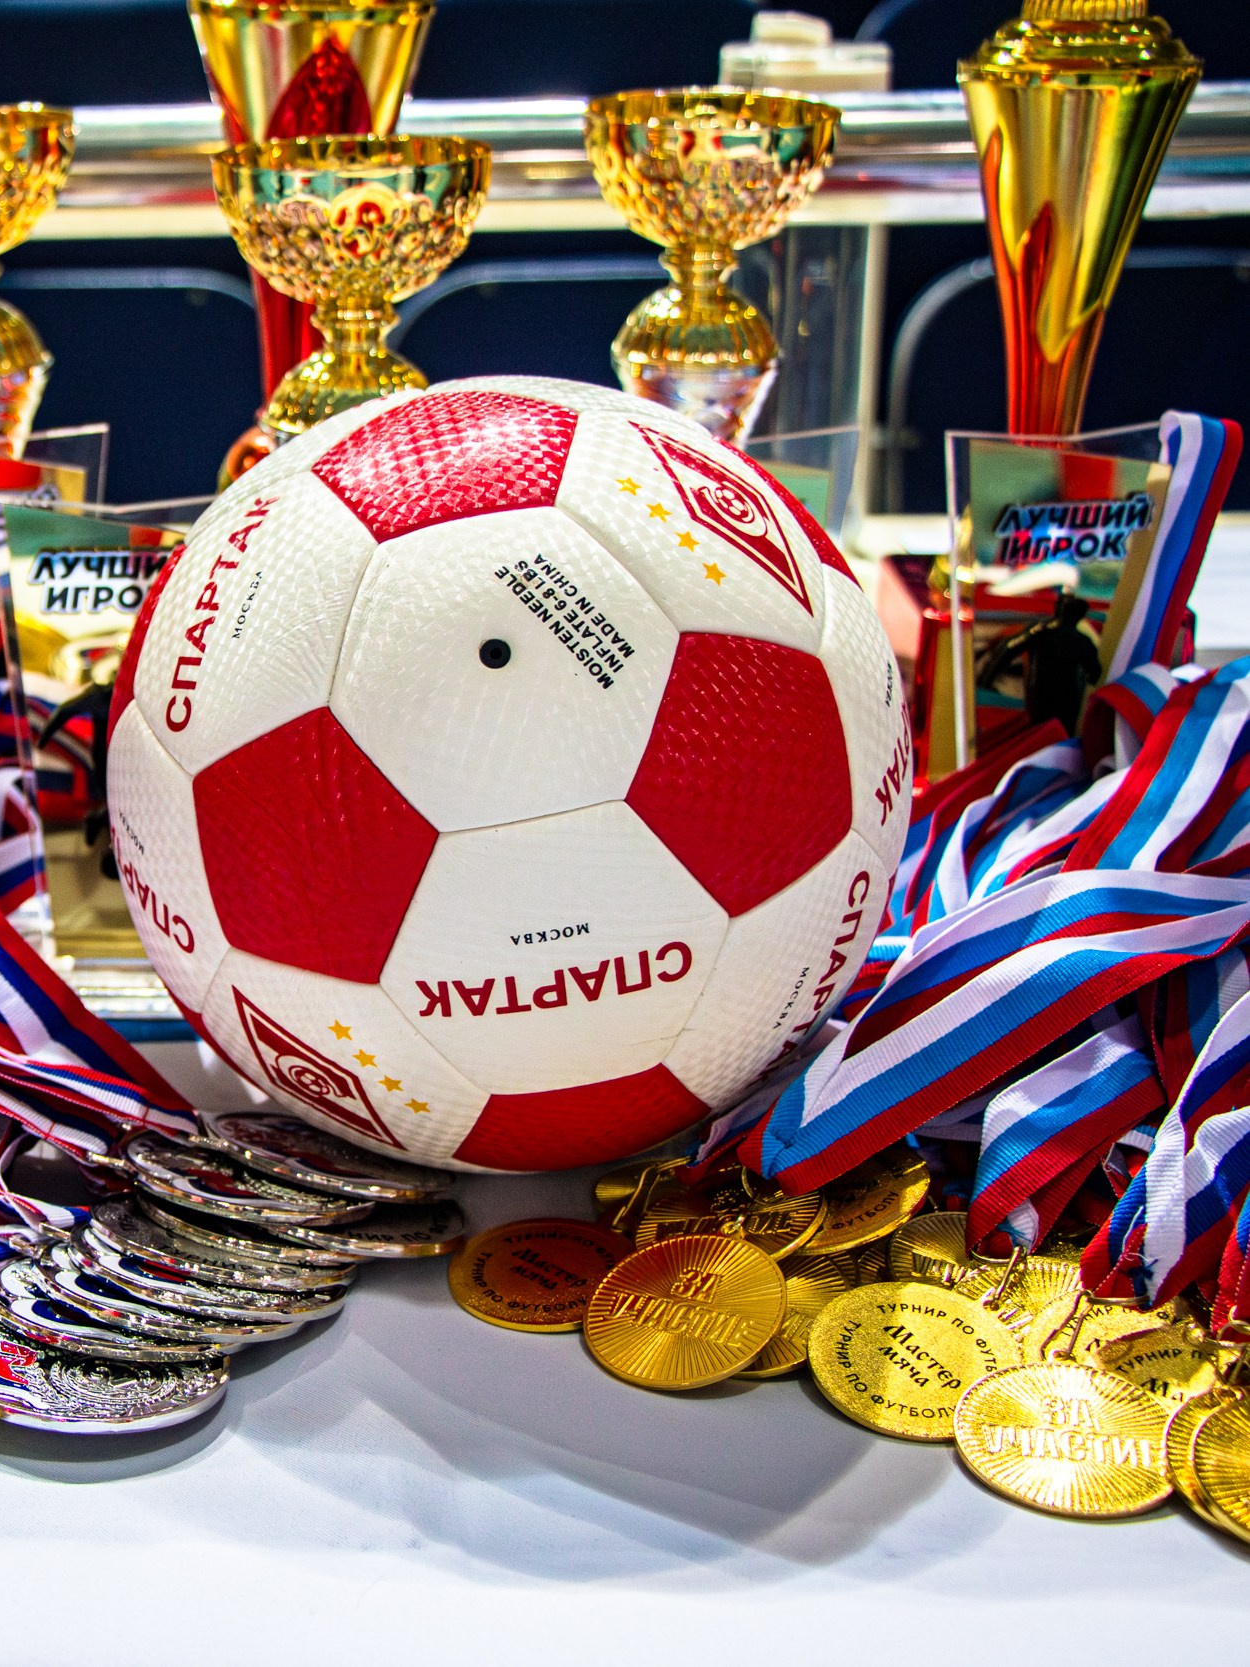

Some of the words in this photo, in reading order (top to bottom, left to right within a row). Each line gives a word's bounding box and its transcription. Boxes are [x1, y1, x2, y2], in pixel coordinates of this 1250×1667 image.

[1000, 494, 1152, 530] ЛУЧШИЙ
[33, 551, 169, 581] ЛУЧШИ
[1004, 532, 1127, 562] ИГРОК
[495, 566, 553, 622] NEEDLE
[515, 560, 546, 590] LBS
[533, 553, 578, 597] CHINA
[45, 584, 145, 611] ИГРО
[165, 495, 281, 732] СПАРТАК
[232, 571, 263, 639] МОСКВА
[542, 588, 567, 611] 6-8
[575, 596, 595, 615] IN
[549, 621, 614, 689] MOISTEN
[563, 609, 624, 673] INFLATE
[591, 613, 635, 659] MADE
[113, 832, 195, 954] СПАРТ
[510, 922, 591, 946] МОСКВА
[415, 941, 693, 1018] СПАРТАК
[831, 1191, 901, 1230] ФУТБОЛУ
[472, 1252, 494, 1288] ТУРНИР
[484, 1289, 503, 1302] ПО
[836, 1320, 862, 1370] ТУРНИР
[877, 1303, 947, 1319] ТУРНИР
[951, 1318, 975, 1335] ПО
[975, 1338, 998, 1373] ФУТБ
[883, 1324, 961, 1390] Мастер
[846, 1373, 868, 1393] ПО
[878, 1346, 930, 1388] мяча
[1115, 1347, 1182, 1375] ТУРНИР
